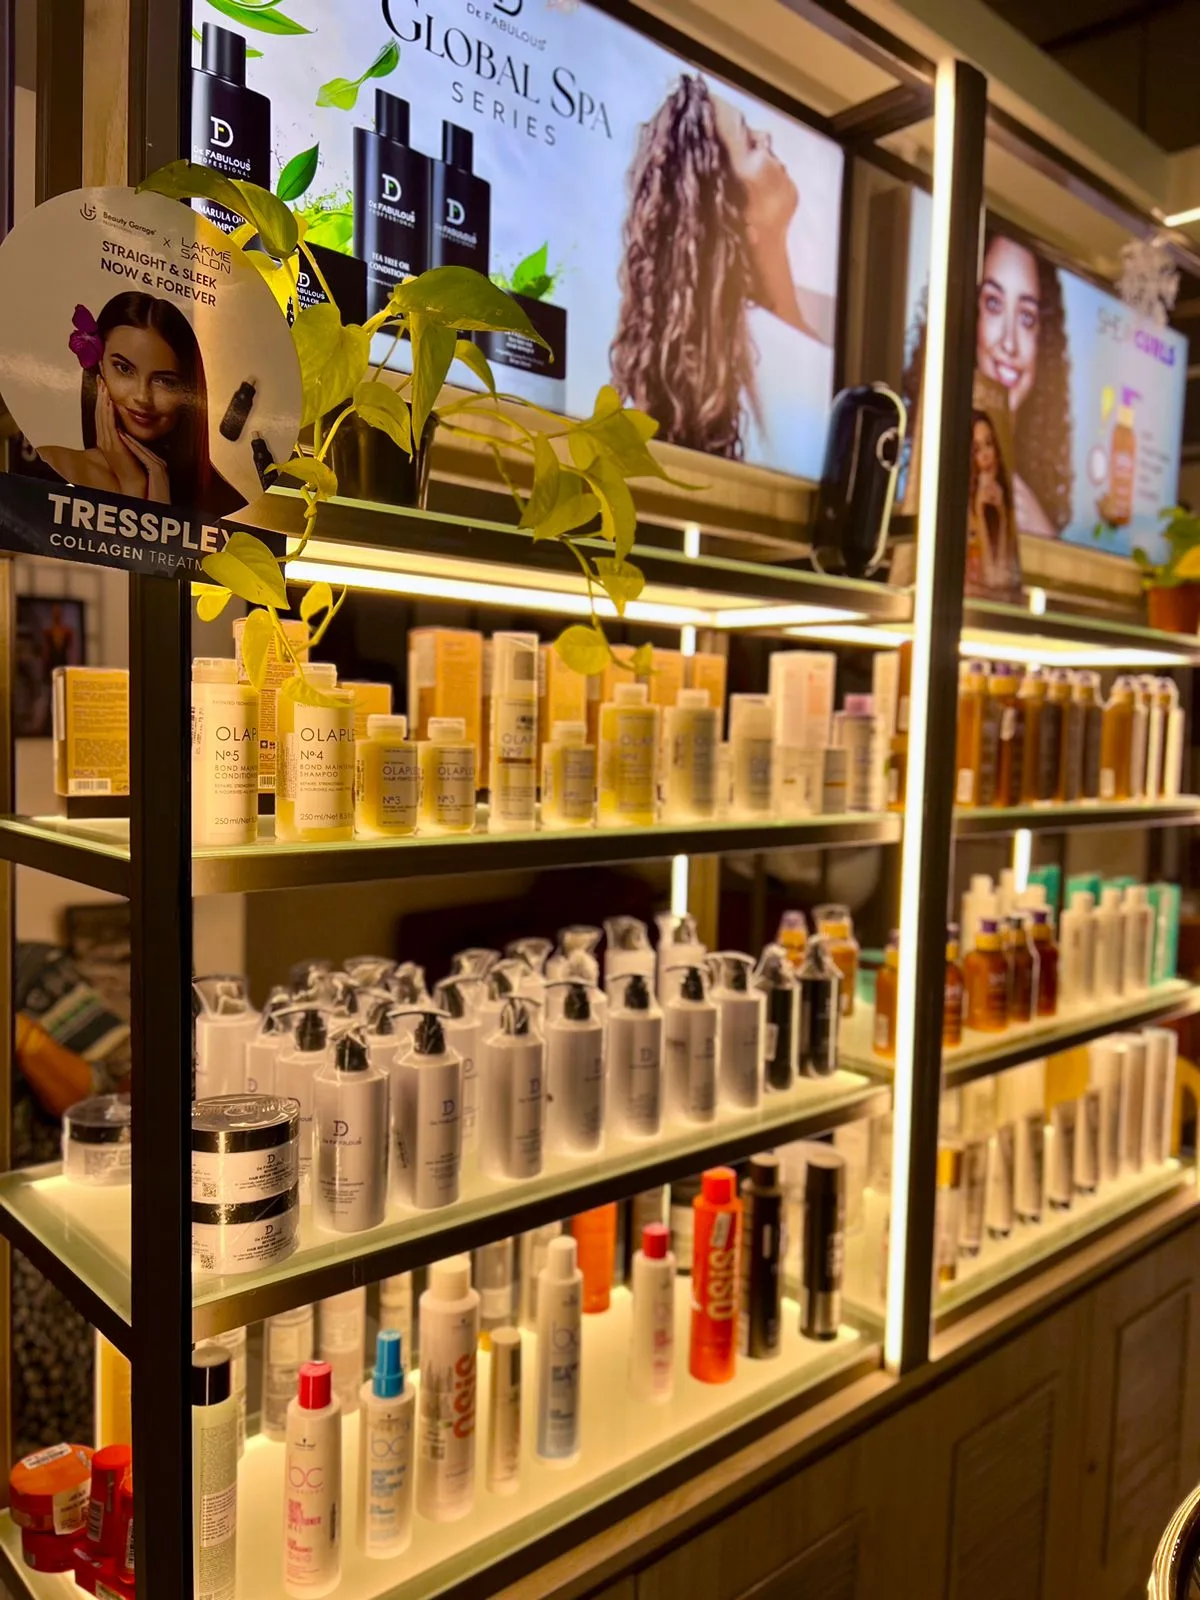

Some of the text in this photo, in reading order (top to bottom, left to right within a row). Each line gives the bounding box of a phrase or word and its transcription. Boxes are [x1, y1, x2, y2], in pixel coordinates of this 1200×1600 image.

[484, 12, 547, 51] FABULOUS
[381, 0, 613, 140] GLOBAL SPA
[451, 80, 557, 147] SERIES
[205, 148, 252, 171] FABULOUS
[102, 210, 128, 227] Beauty
[128, 219, 157, 236] Garage
[198, 203, 232, 222] MARULA
[378, 202, 416, 223] FABULOUS
[102, 239, 218, 291] STRAIGHT & SLEEK
[179, 247, 232, 275] SALON
[100, 256, 218, 308] NOW & FOREVER
[49, 532, 144, 562] COLLAGEN
[214, 764, 238, 772] BOND
[299, 763, 323, 771] BOND
[299, 770, 339, 778] SHAMPOO
[214, 817, 230, 825] 250
[299, 813, 314, 821] 250
